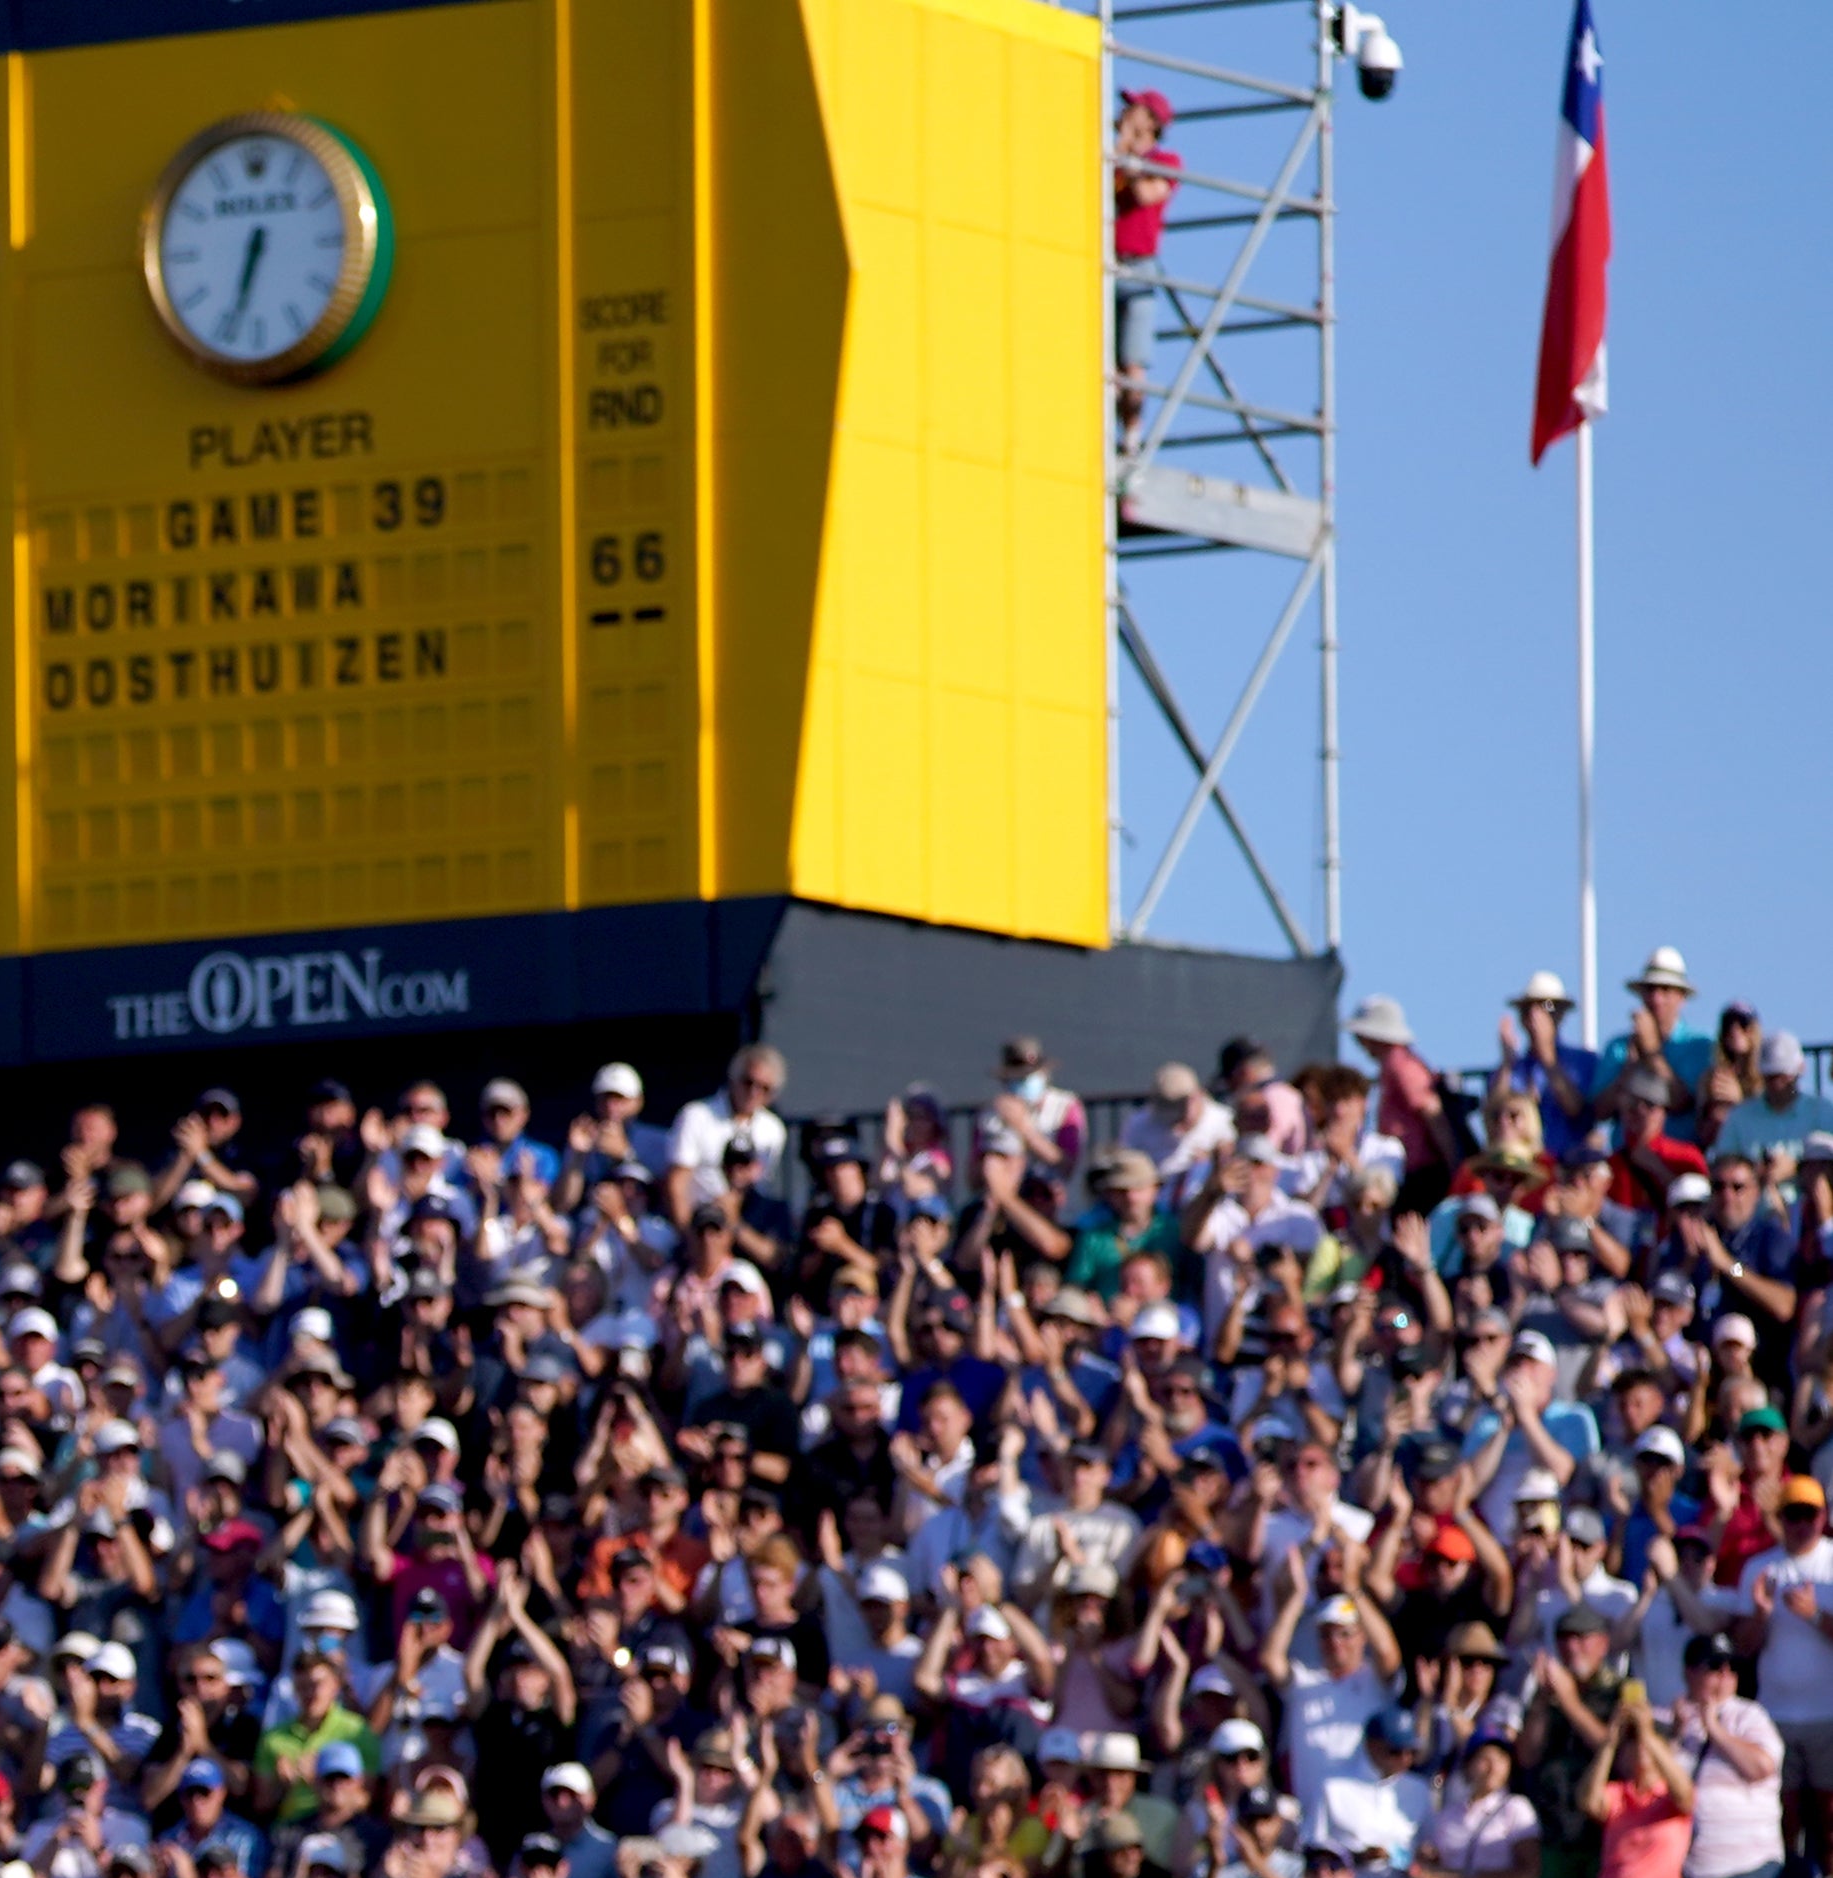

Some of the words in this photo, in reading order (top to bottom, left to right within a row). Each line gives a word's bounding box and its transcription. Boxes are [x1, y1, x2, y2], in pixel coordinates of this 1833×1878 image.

[582, 290, 668, 331] SCORE
[598, 338, 653, 376] FOR
[588, 381, 664, 430] RND
[189, 410, 373, 469] PLAYER
[167, 489, 322, 550] GAME
[372, 477, 445, 531] 39
[591, 531, 664, 587] 66
[45, 628, 448, 711] OOSTHUIZEN
